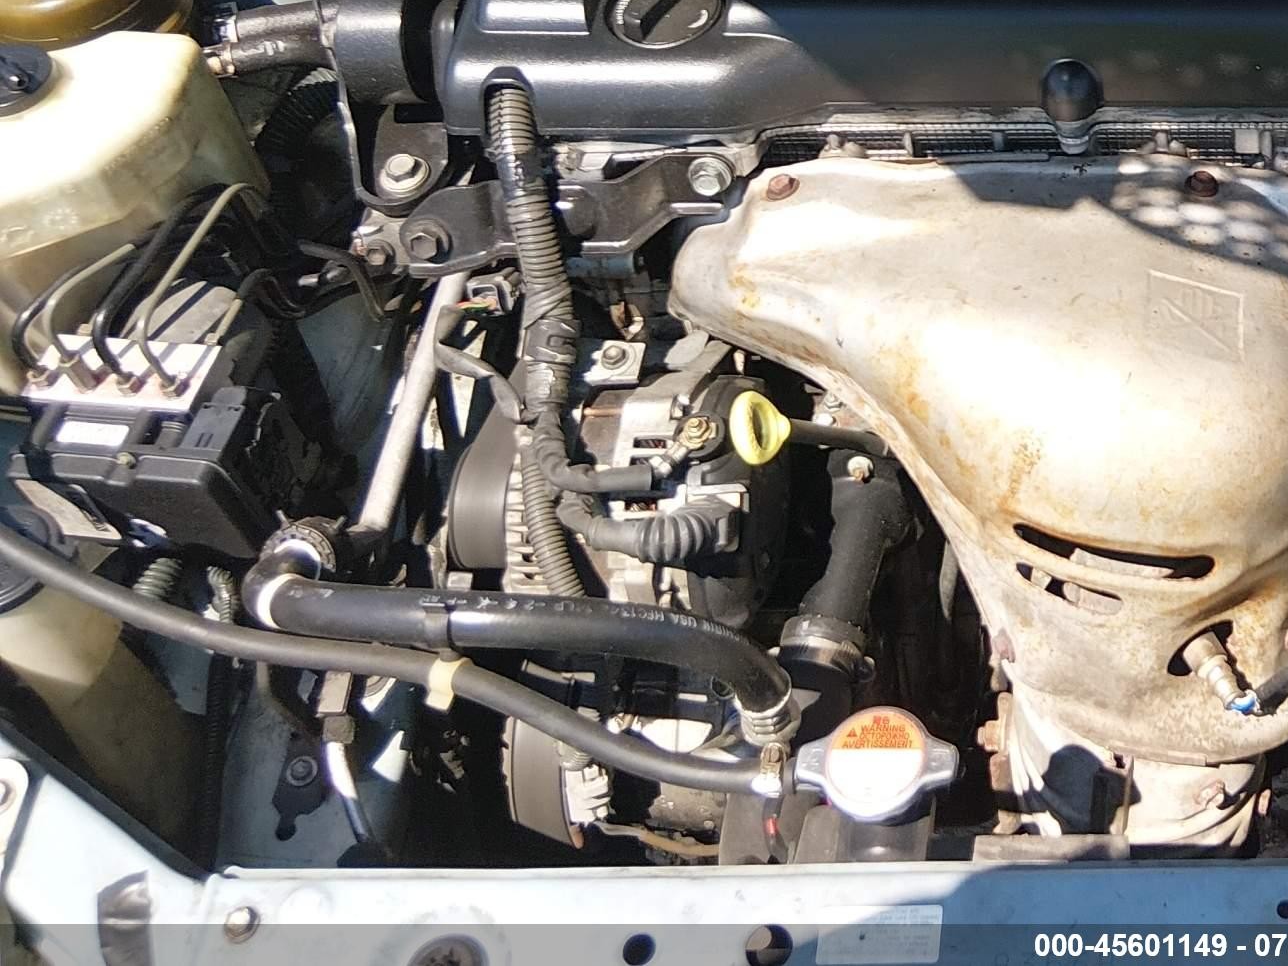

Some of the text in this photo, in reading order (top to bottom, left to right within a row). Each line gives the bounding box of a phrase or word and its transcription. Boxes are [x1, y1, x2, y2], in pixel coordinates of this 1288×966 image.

[670, 612, 697, 628] USA
[860, 724, 906, 732] WARNING
[841, 739, 913, 749] AVERTISSEMENT
